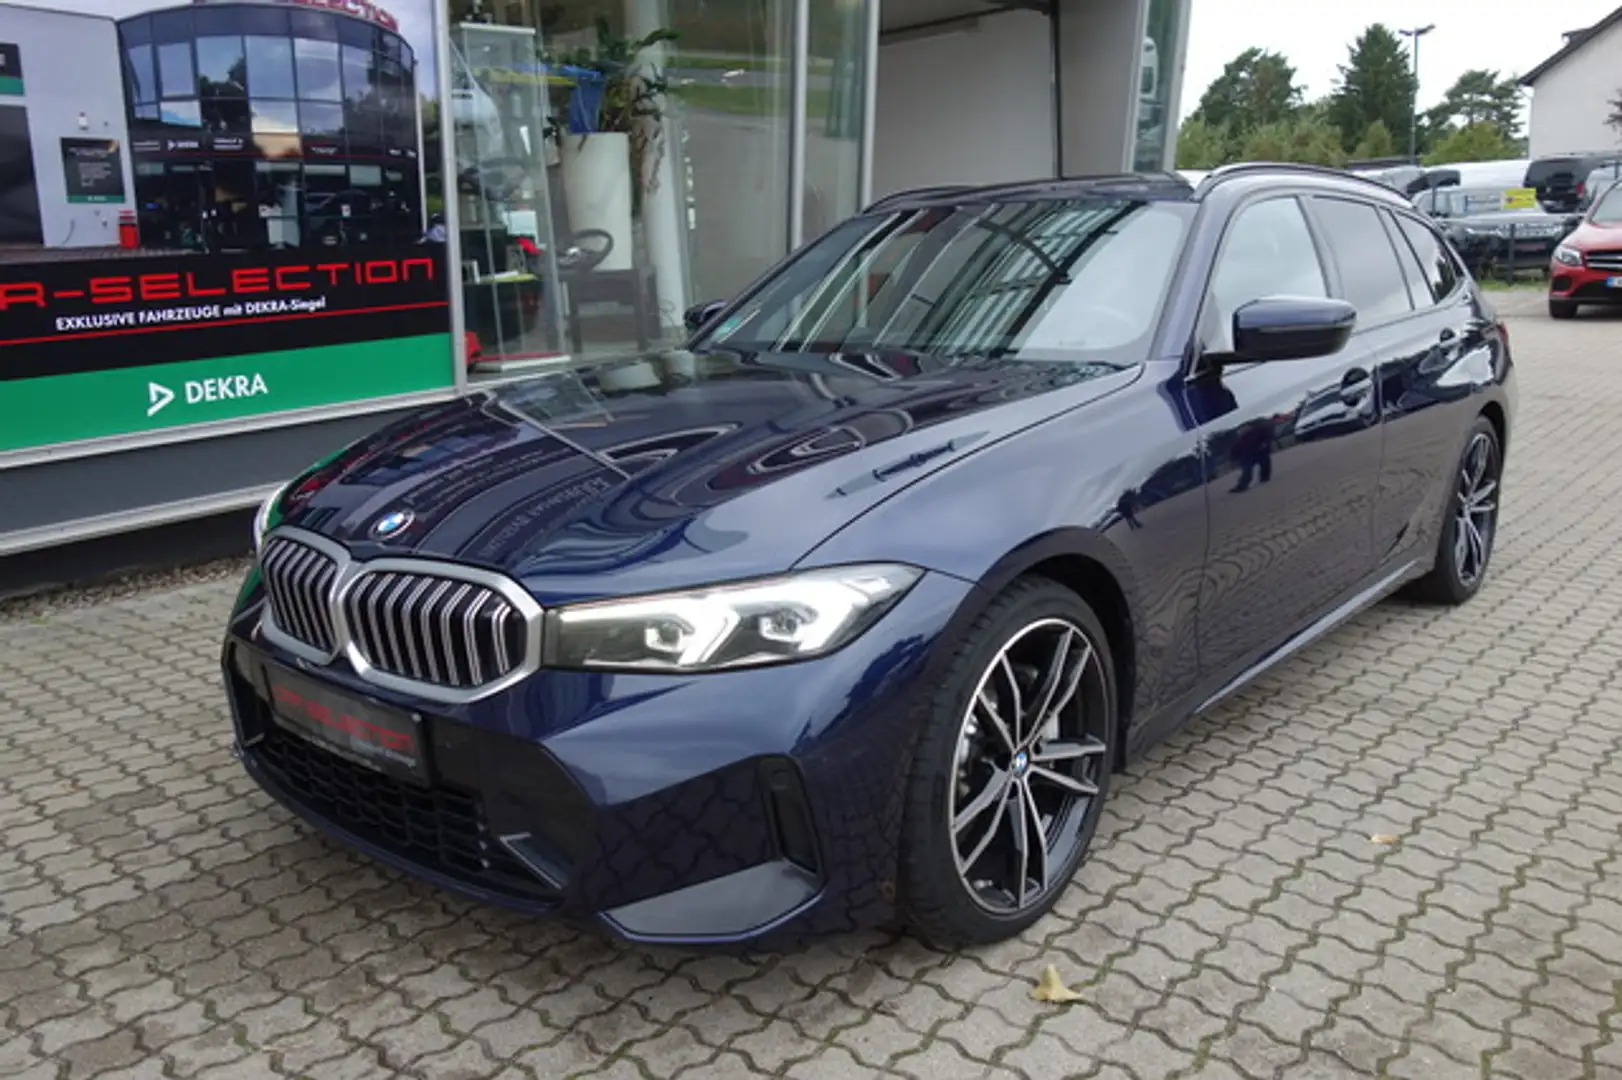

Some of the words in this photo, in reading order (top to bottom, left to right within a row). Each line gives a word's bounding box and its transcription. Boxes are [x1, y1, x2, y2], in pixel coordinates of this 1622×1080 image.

[55, 311, 136, 331] EXKLUSIVE
[138, 303, 221, 325] FAHRZEUGE
[222, 306, 243, 317] mit
[245, 295, 327, 315] DEKRA-Siegel
[184, 372, 269, 405] DEKRA
